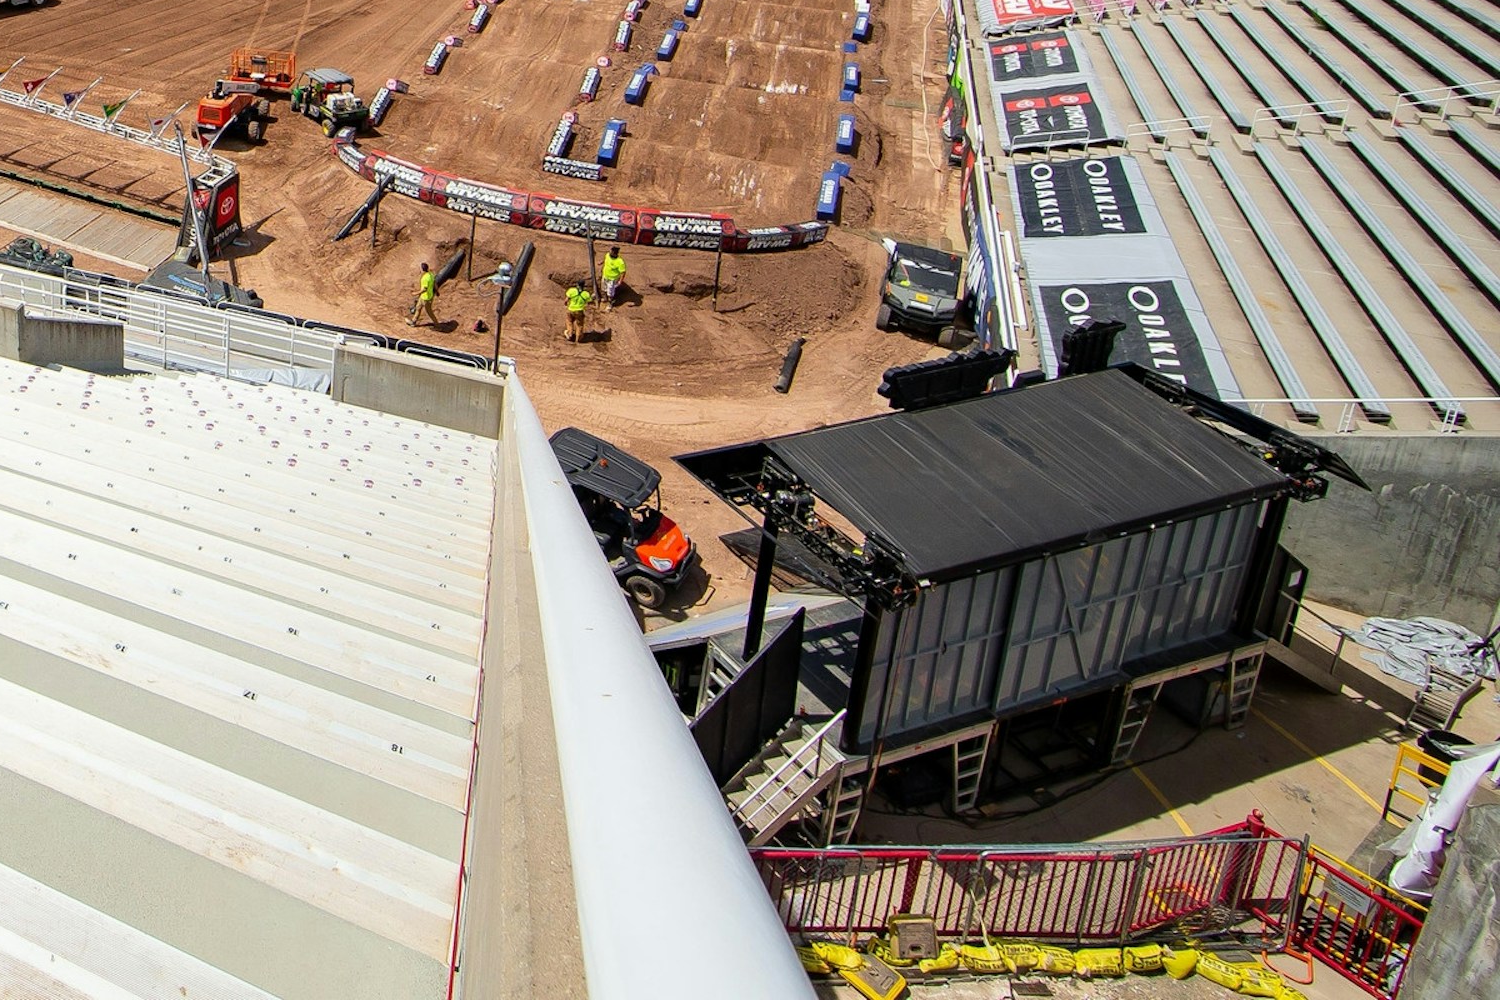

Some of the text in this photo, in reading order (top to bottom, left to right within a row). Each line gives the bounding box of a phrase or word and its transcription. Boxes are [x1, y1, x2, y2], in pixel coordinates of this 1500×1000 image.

[579, 204, 620, 216] MOUNTAIN
[1033, 180, 1064, 234] OAKLEY
[1088, 177, 1125, 232] OAKLEY
[665, 216, 723, 226] ROCKY MOUNTAIN
[687, 233, 722, 242] MOUNTAIN
